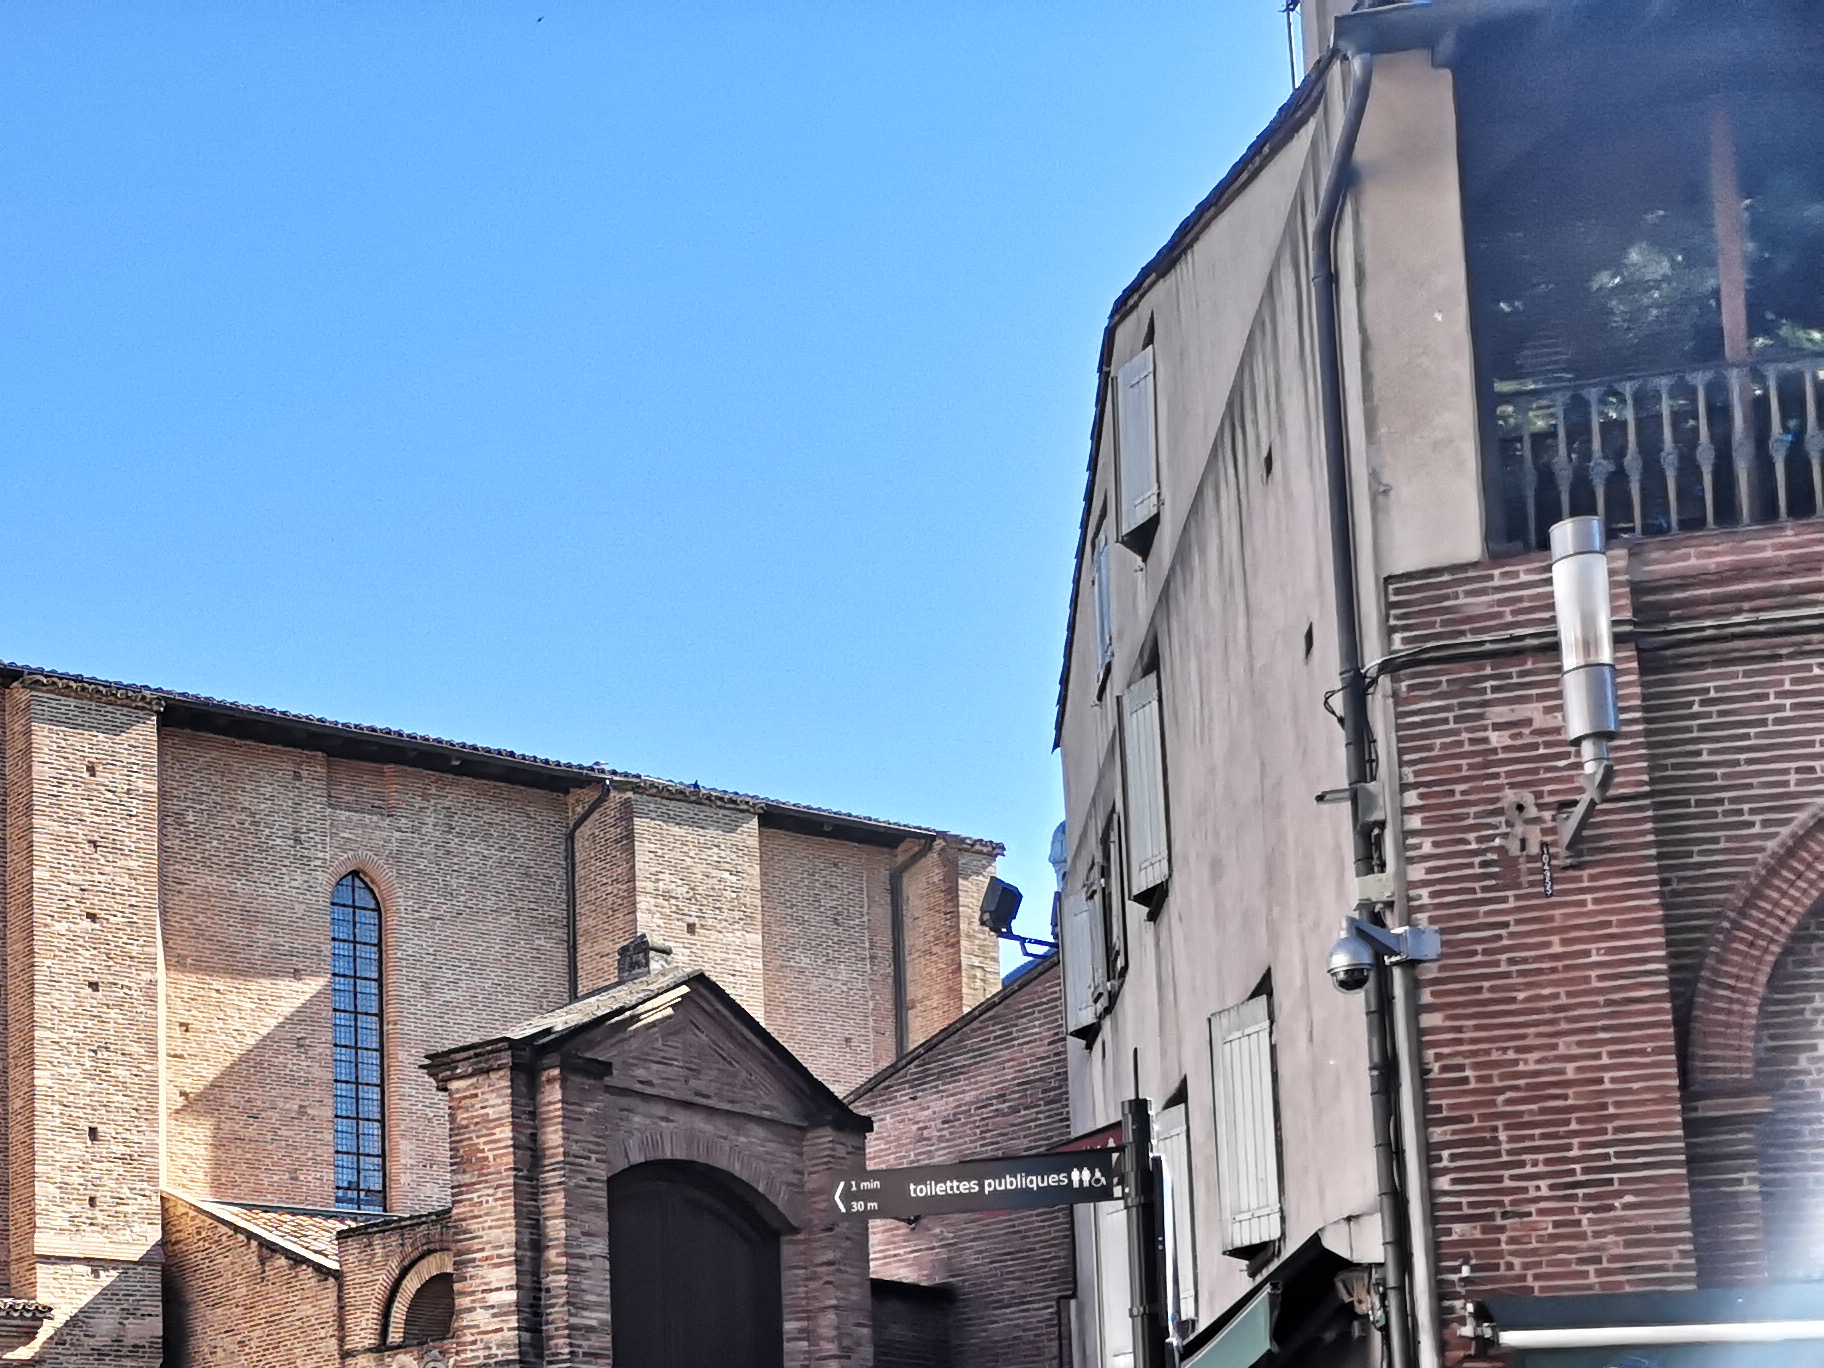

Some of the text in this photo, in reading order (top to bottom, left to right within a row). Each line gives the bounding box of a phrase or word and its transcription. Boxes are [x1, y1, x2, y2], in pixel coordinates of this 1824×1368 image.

[851, 1178, 881, 1191] 1 min
[909, 1171, 1068, 1197] toilettes publiques
[851, 1201, 878, 1213] 30 m
